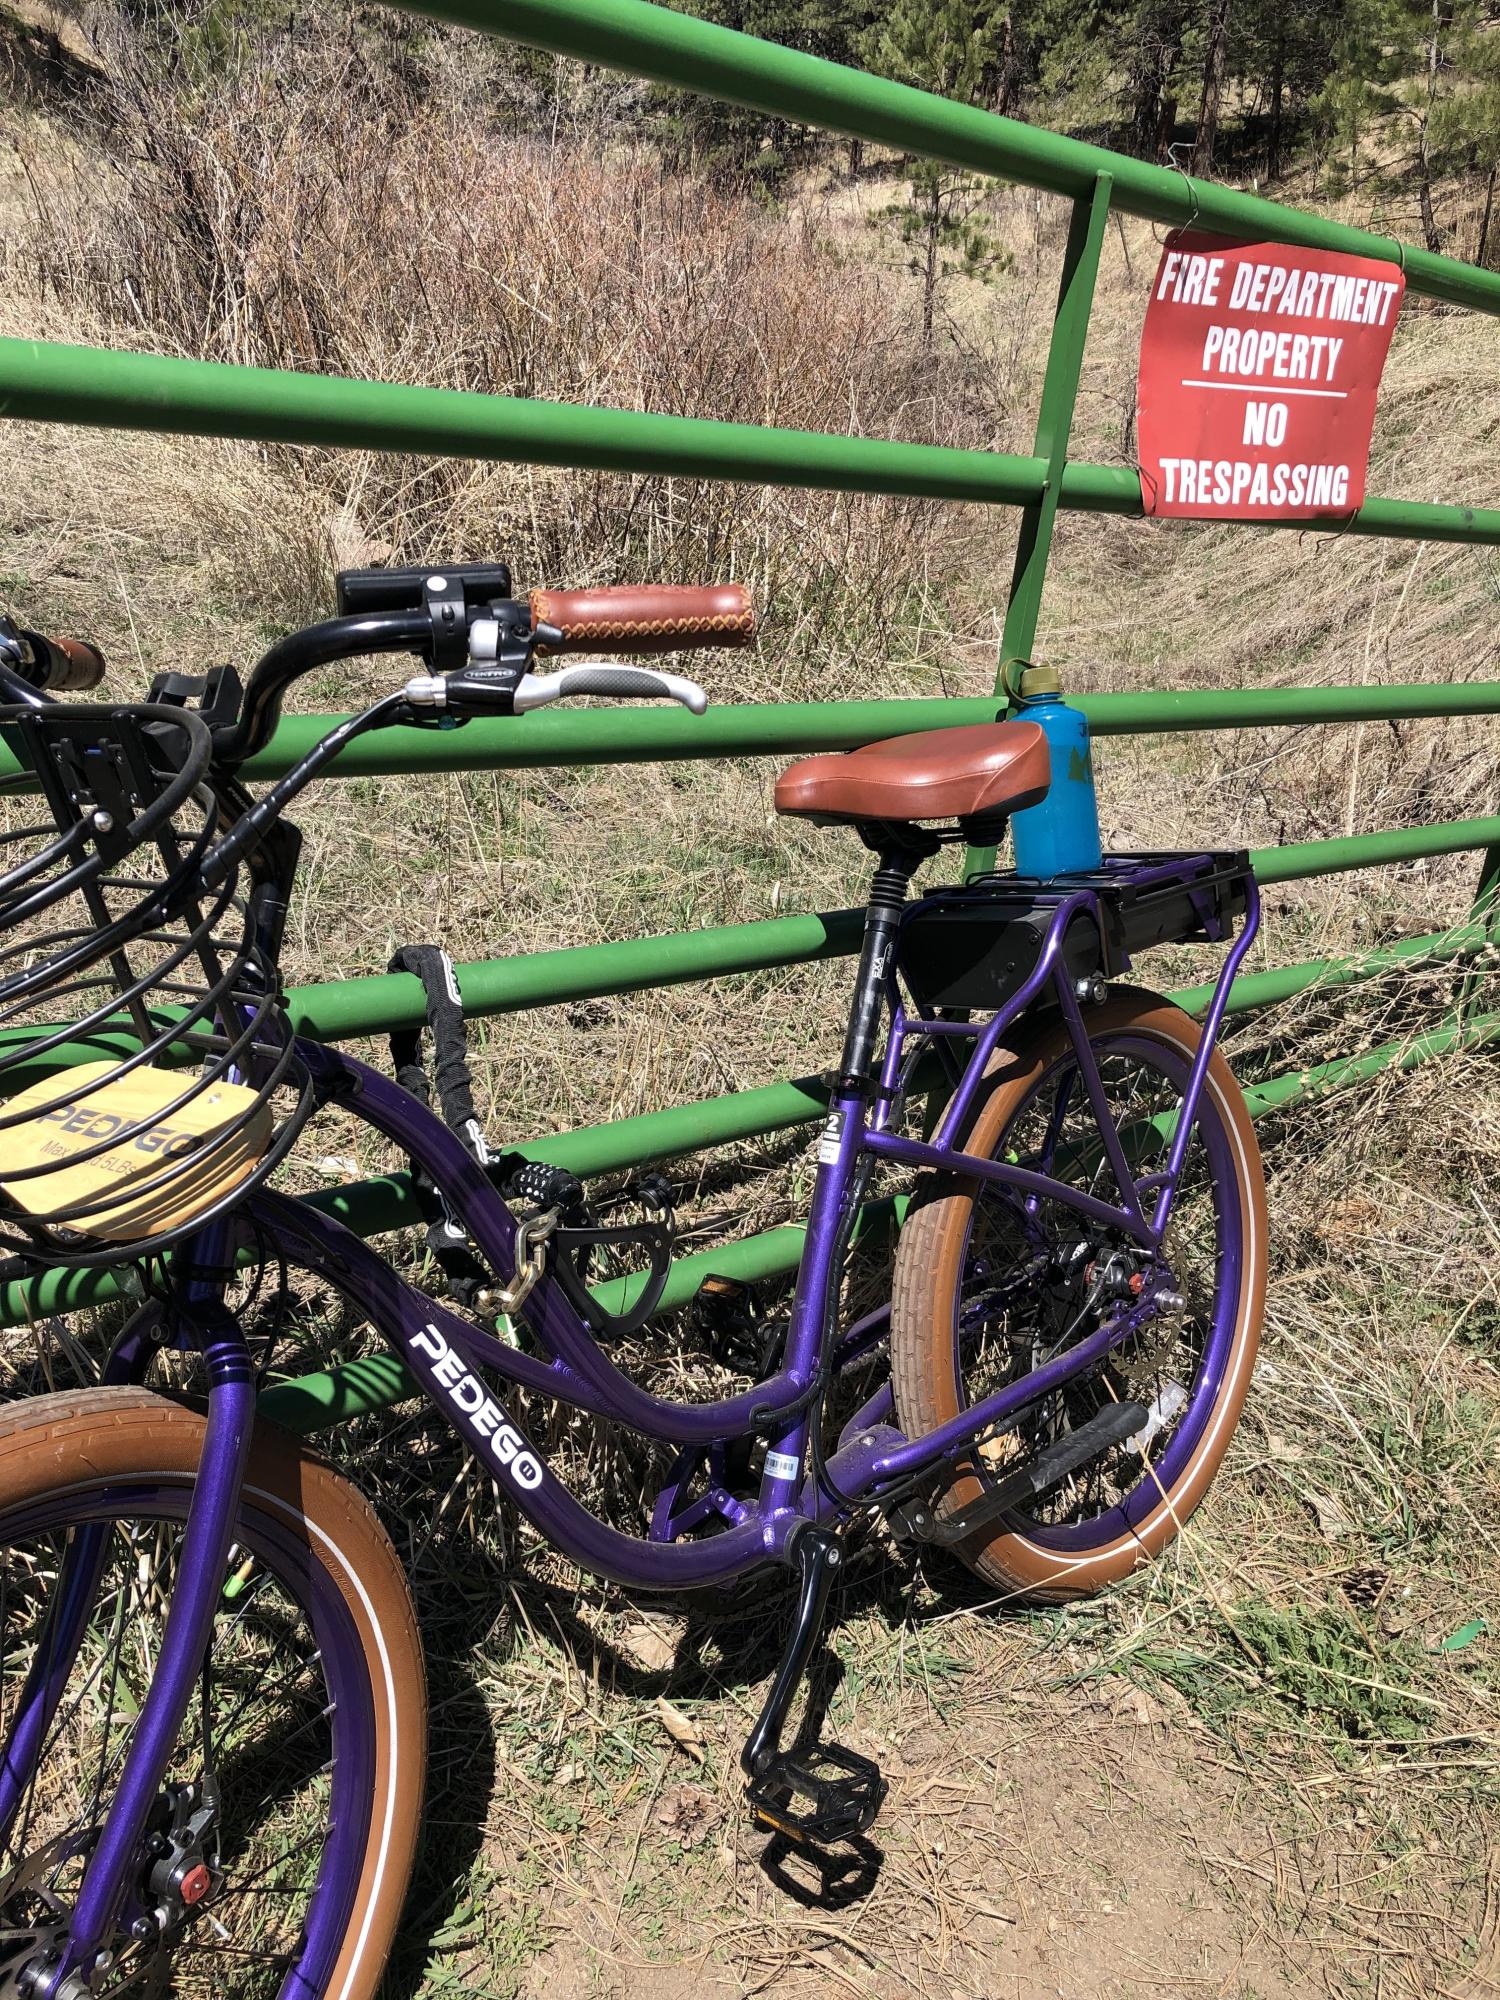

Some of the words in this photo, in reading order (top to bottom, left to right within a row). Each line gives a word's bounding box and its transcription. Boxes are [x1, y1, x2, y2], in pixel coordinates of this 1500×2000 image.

[1156, 252, 1225, 307] FIRE
[1228, 261, 1398, 326] DEPARTMENT
[1202, 325, 1343, 381] PROPERTY
[1242, 401, 1288, 447] NO
[1159, 457, 1350, 507] TRESPASSING
[40, 1140, 71, 1157] Max
[408, 1323, 543, 1490] PEDEGO
